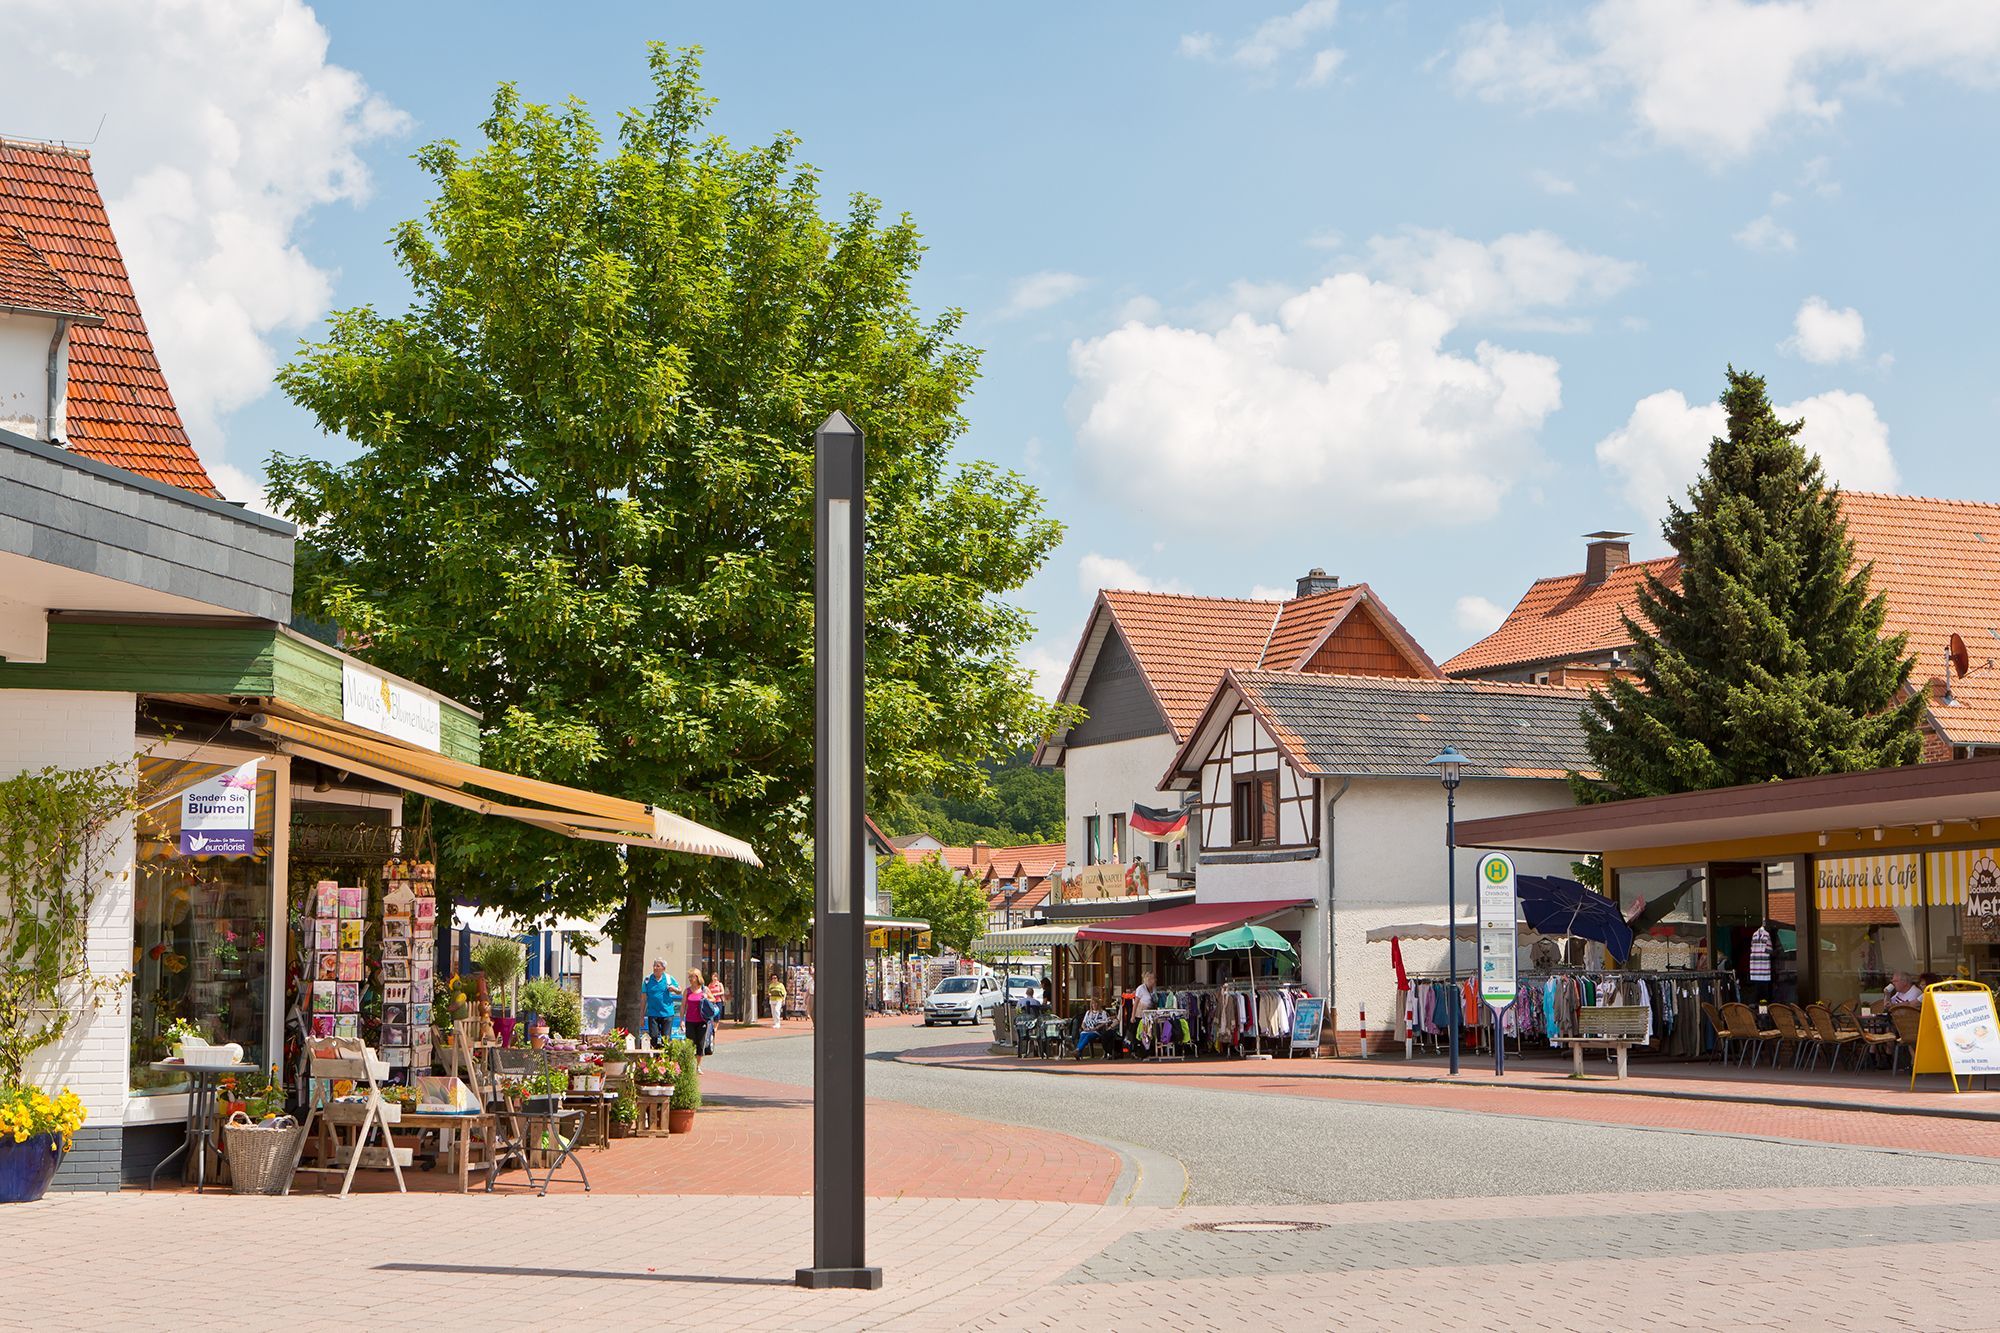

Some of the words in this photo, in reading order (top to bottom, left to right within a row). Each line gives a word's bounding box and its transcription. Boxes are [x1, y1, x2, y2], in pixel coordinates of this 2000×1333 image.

[391, 691, 438, 736] Blumenladen
[189, 793, 226, 802] Senden
[230, 793, 245, 802] Sie
[188, 803, 245, 814] Blumen
[205, 843, 245, 852] euroflorist
[1491, 864, 1503, 877] H
[1817, 867, 1869, 889] Bäckerei
[1872, 866, 1884, 886] &
[1887, 864, 1917, 890] Café
[1980, 874, 1992, 884] Der
[1967, 895, 2000, 916] Met
